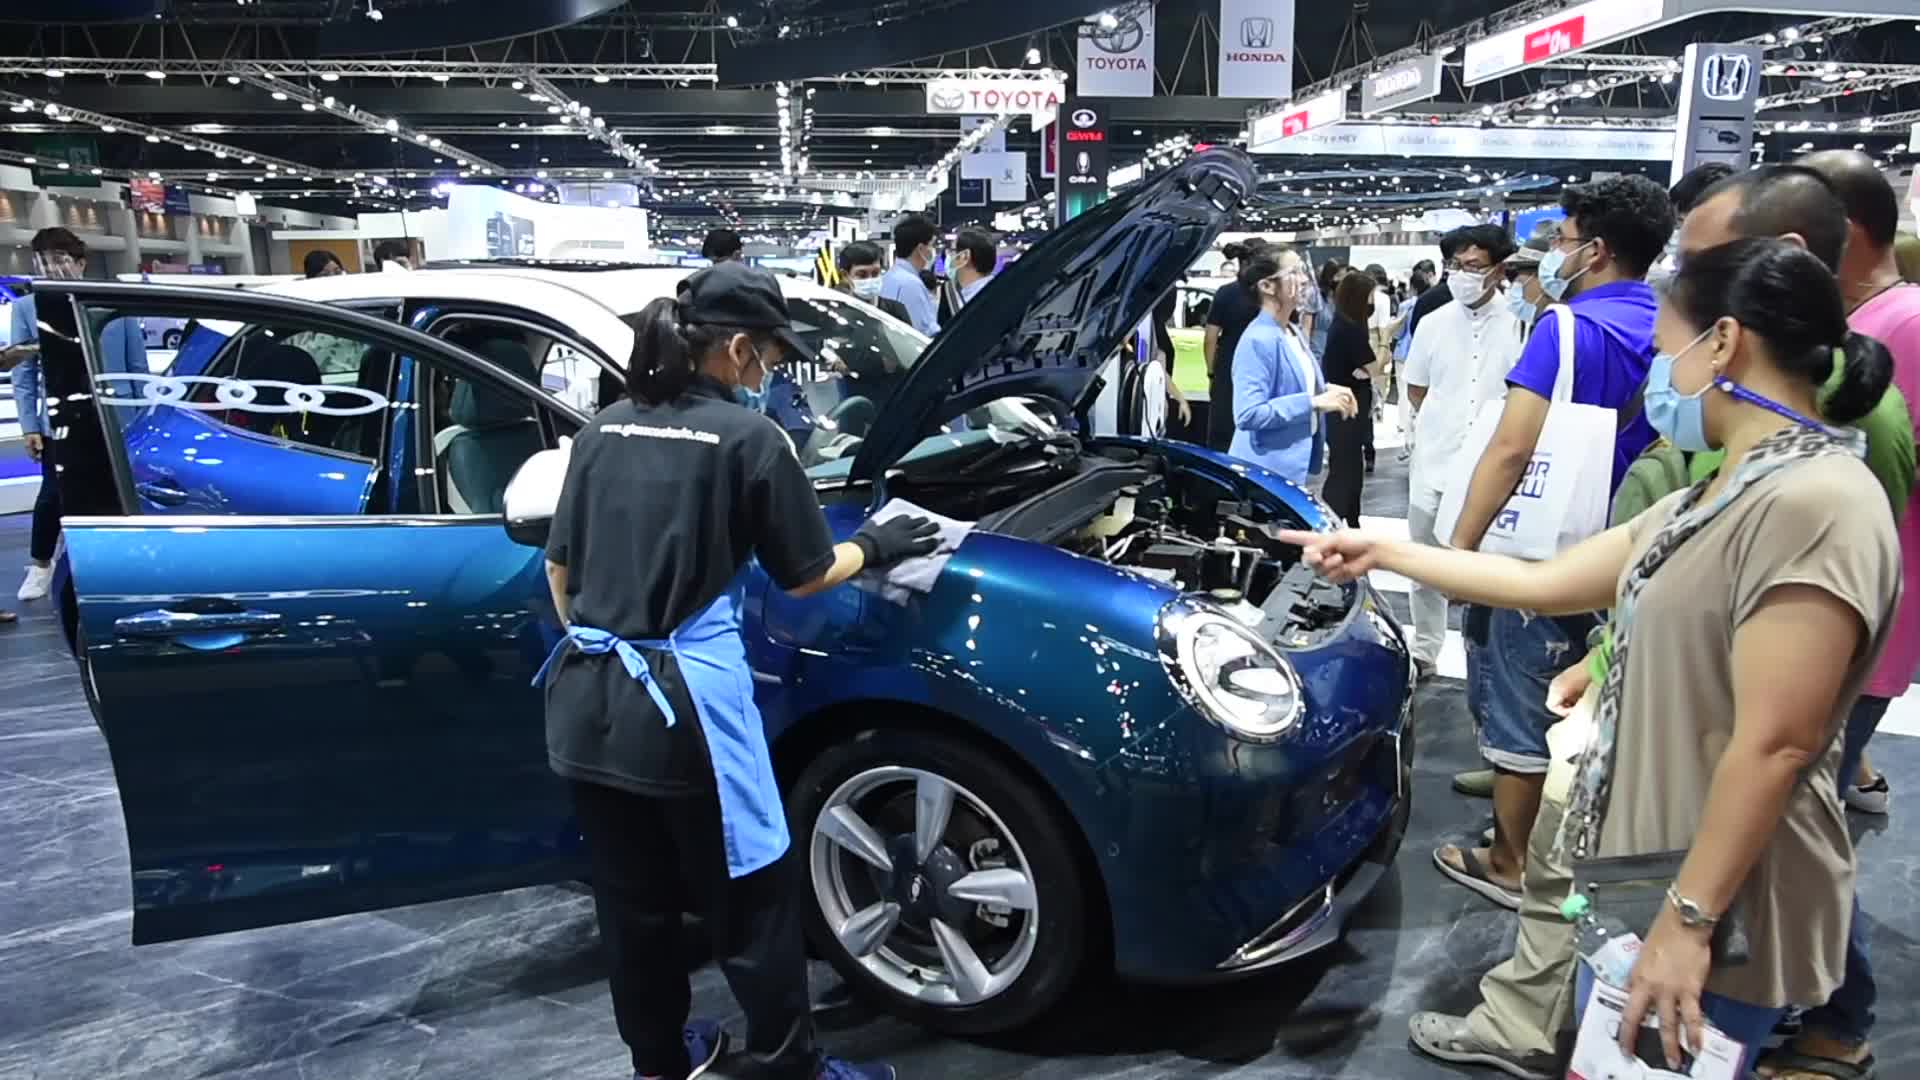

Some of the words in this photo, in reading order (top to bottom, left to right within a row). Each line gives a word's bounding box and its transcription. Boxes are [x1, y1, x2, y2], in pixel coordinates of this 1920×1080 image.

[1086, 56, 1147, 71] TOYOTA
[1225, 52, 1287, 63] HONDA
[969, 89, 1058, 110] TOYOTA
[1068, 175, 1097, 184] ORA
